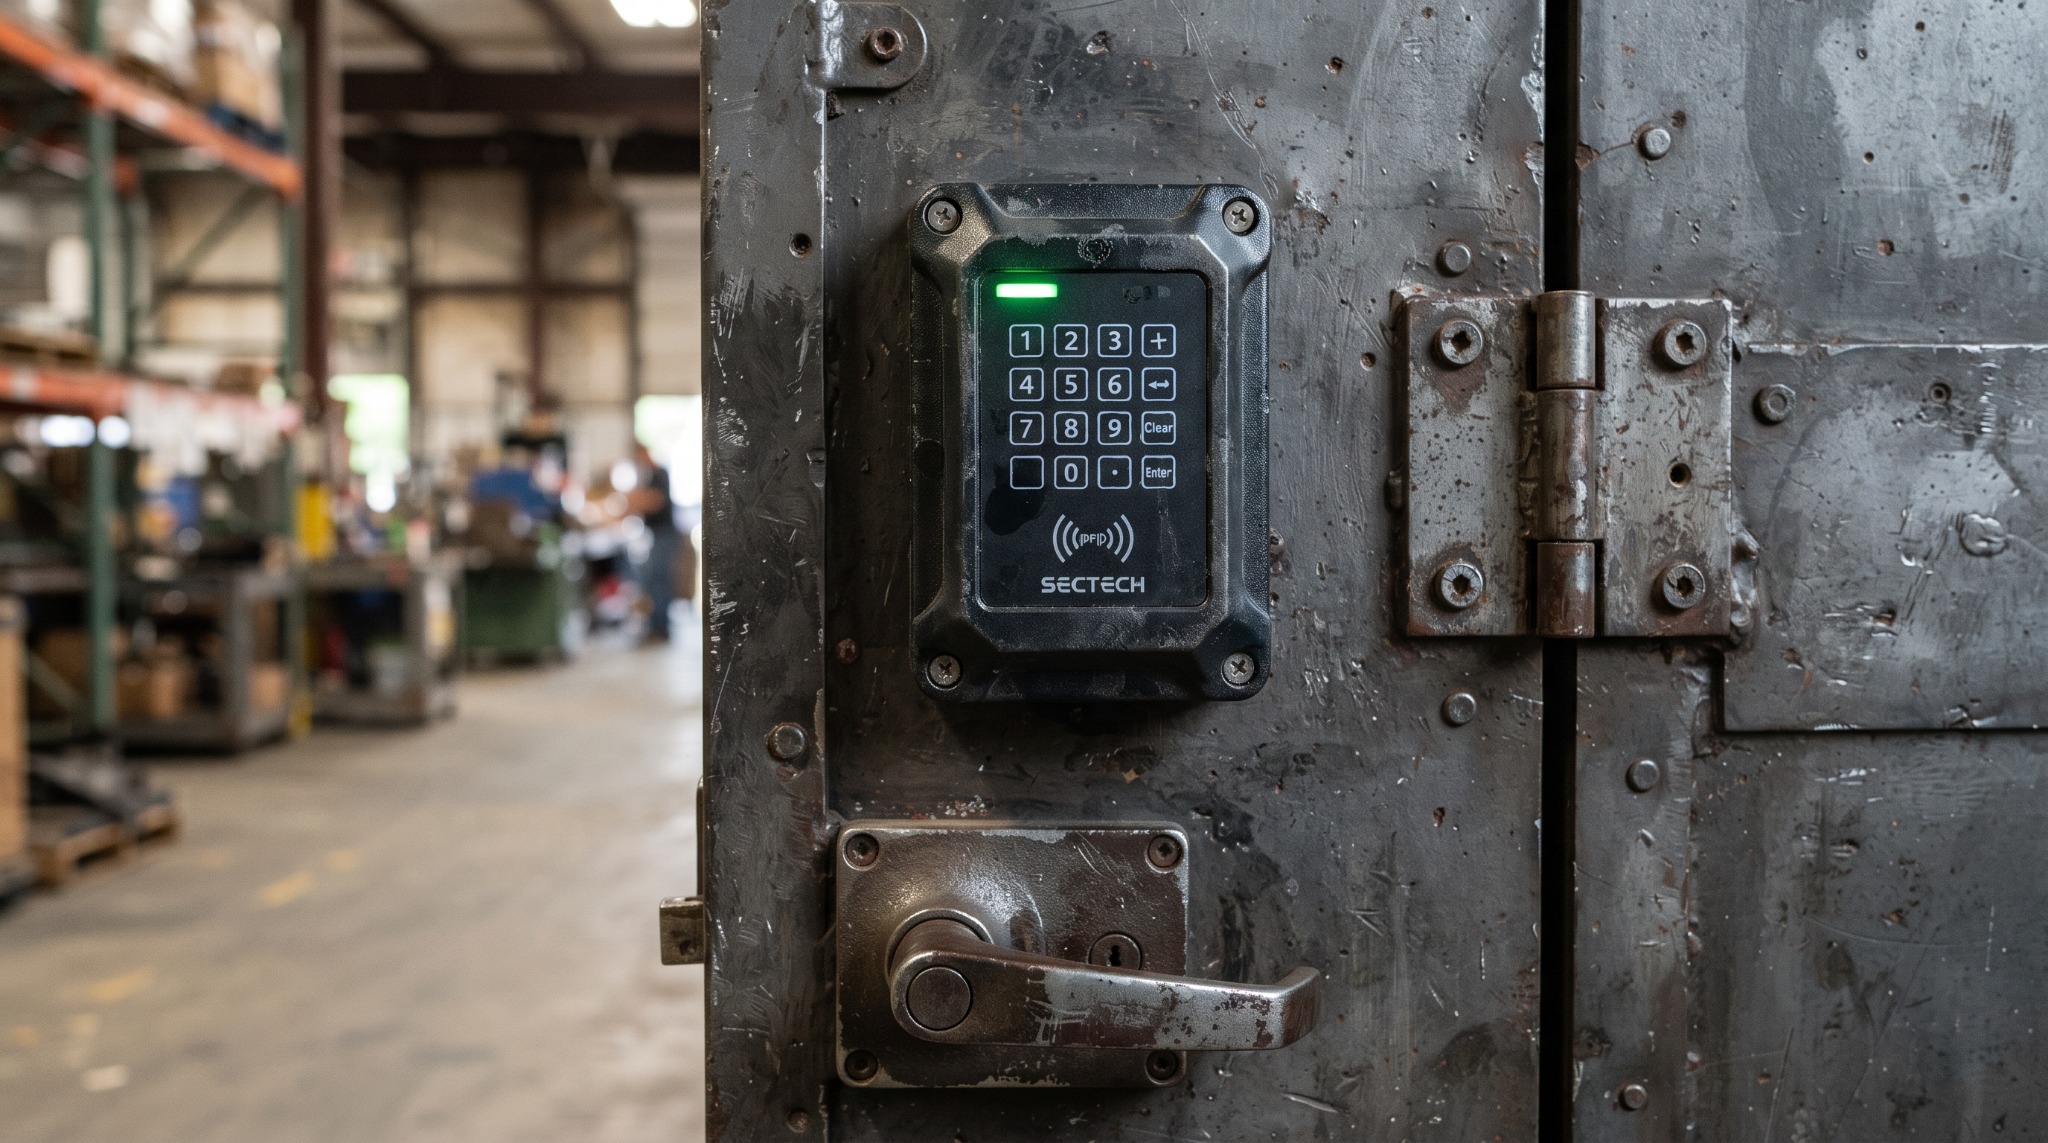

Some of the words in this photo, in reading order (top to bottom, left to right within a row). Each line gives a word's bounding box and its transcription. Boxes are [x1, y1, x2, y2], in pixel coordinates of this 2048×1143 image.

[1021, 331, 1029, 350] 1
[1065, 331, 1078, 350] 2
[1109, 331, 1121, 350] 3
[1019, 375, 1034, 394] 4
[1065, 375, 1077, 394] 5
[1108, 374, 1122, 394] 6
[1020, 419, 1033, 438] 7
[1065, 418, 1078, 438] 8
[1108, 419, 1121, 437] 9
[1144, 421, 1174, 434] Clear
[1065, 463, 1078, 482] 0
[1145, 467, 1173, 479] Enter
[1041, 577, 1144, 593] SECTECH
